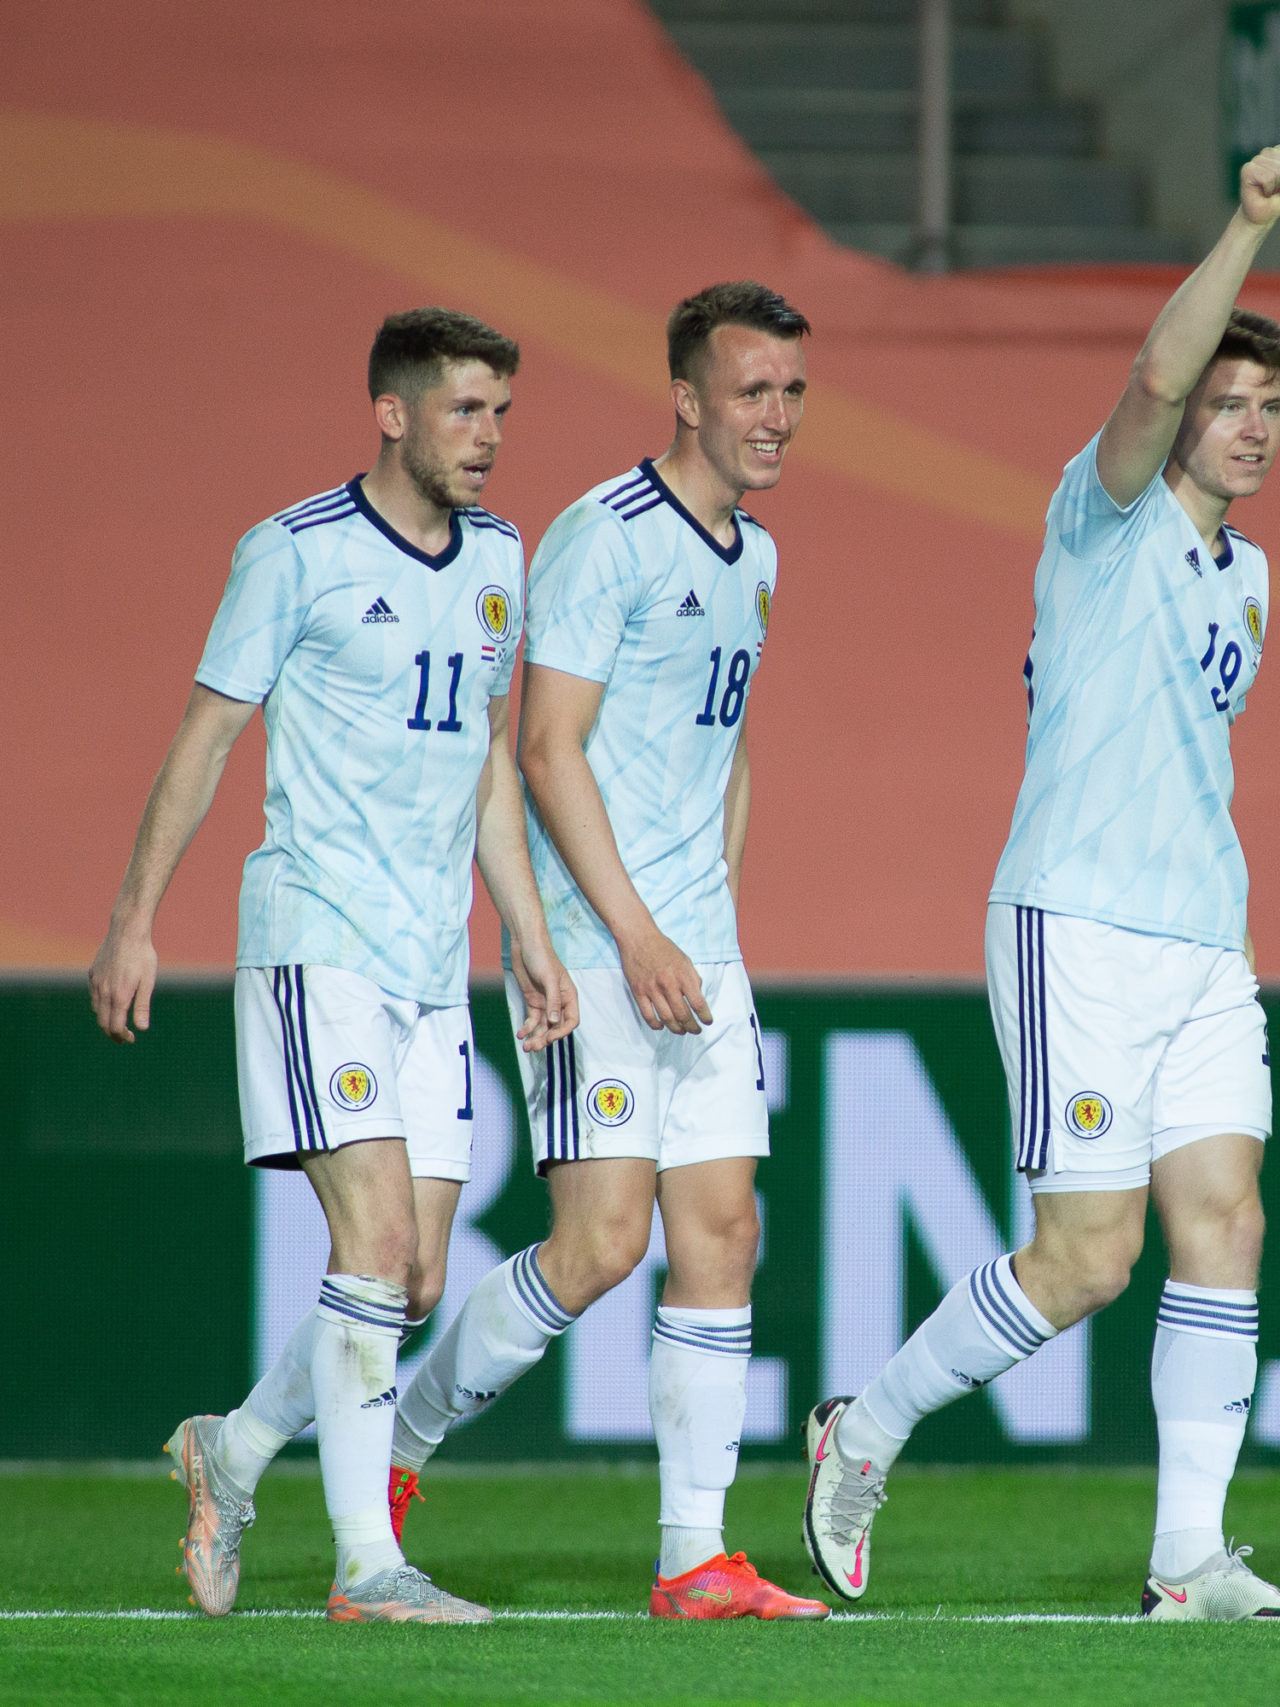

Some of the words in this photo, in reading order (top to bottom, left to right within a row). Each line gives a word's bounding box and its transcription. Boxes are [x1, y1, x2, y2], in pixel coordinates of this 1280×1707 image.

[361, 613, 400, 624] adidas
[676, 606, 706, 617] adidas
[407, 650, 464, 732] 11
[696, 646, 751, 728] 18
[1200, 622, 1242, 712] 19
